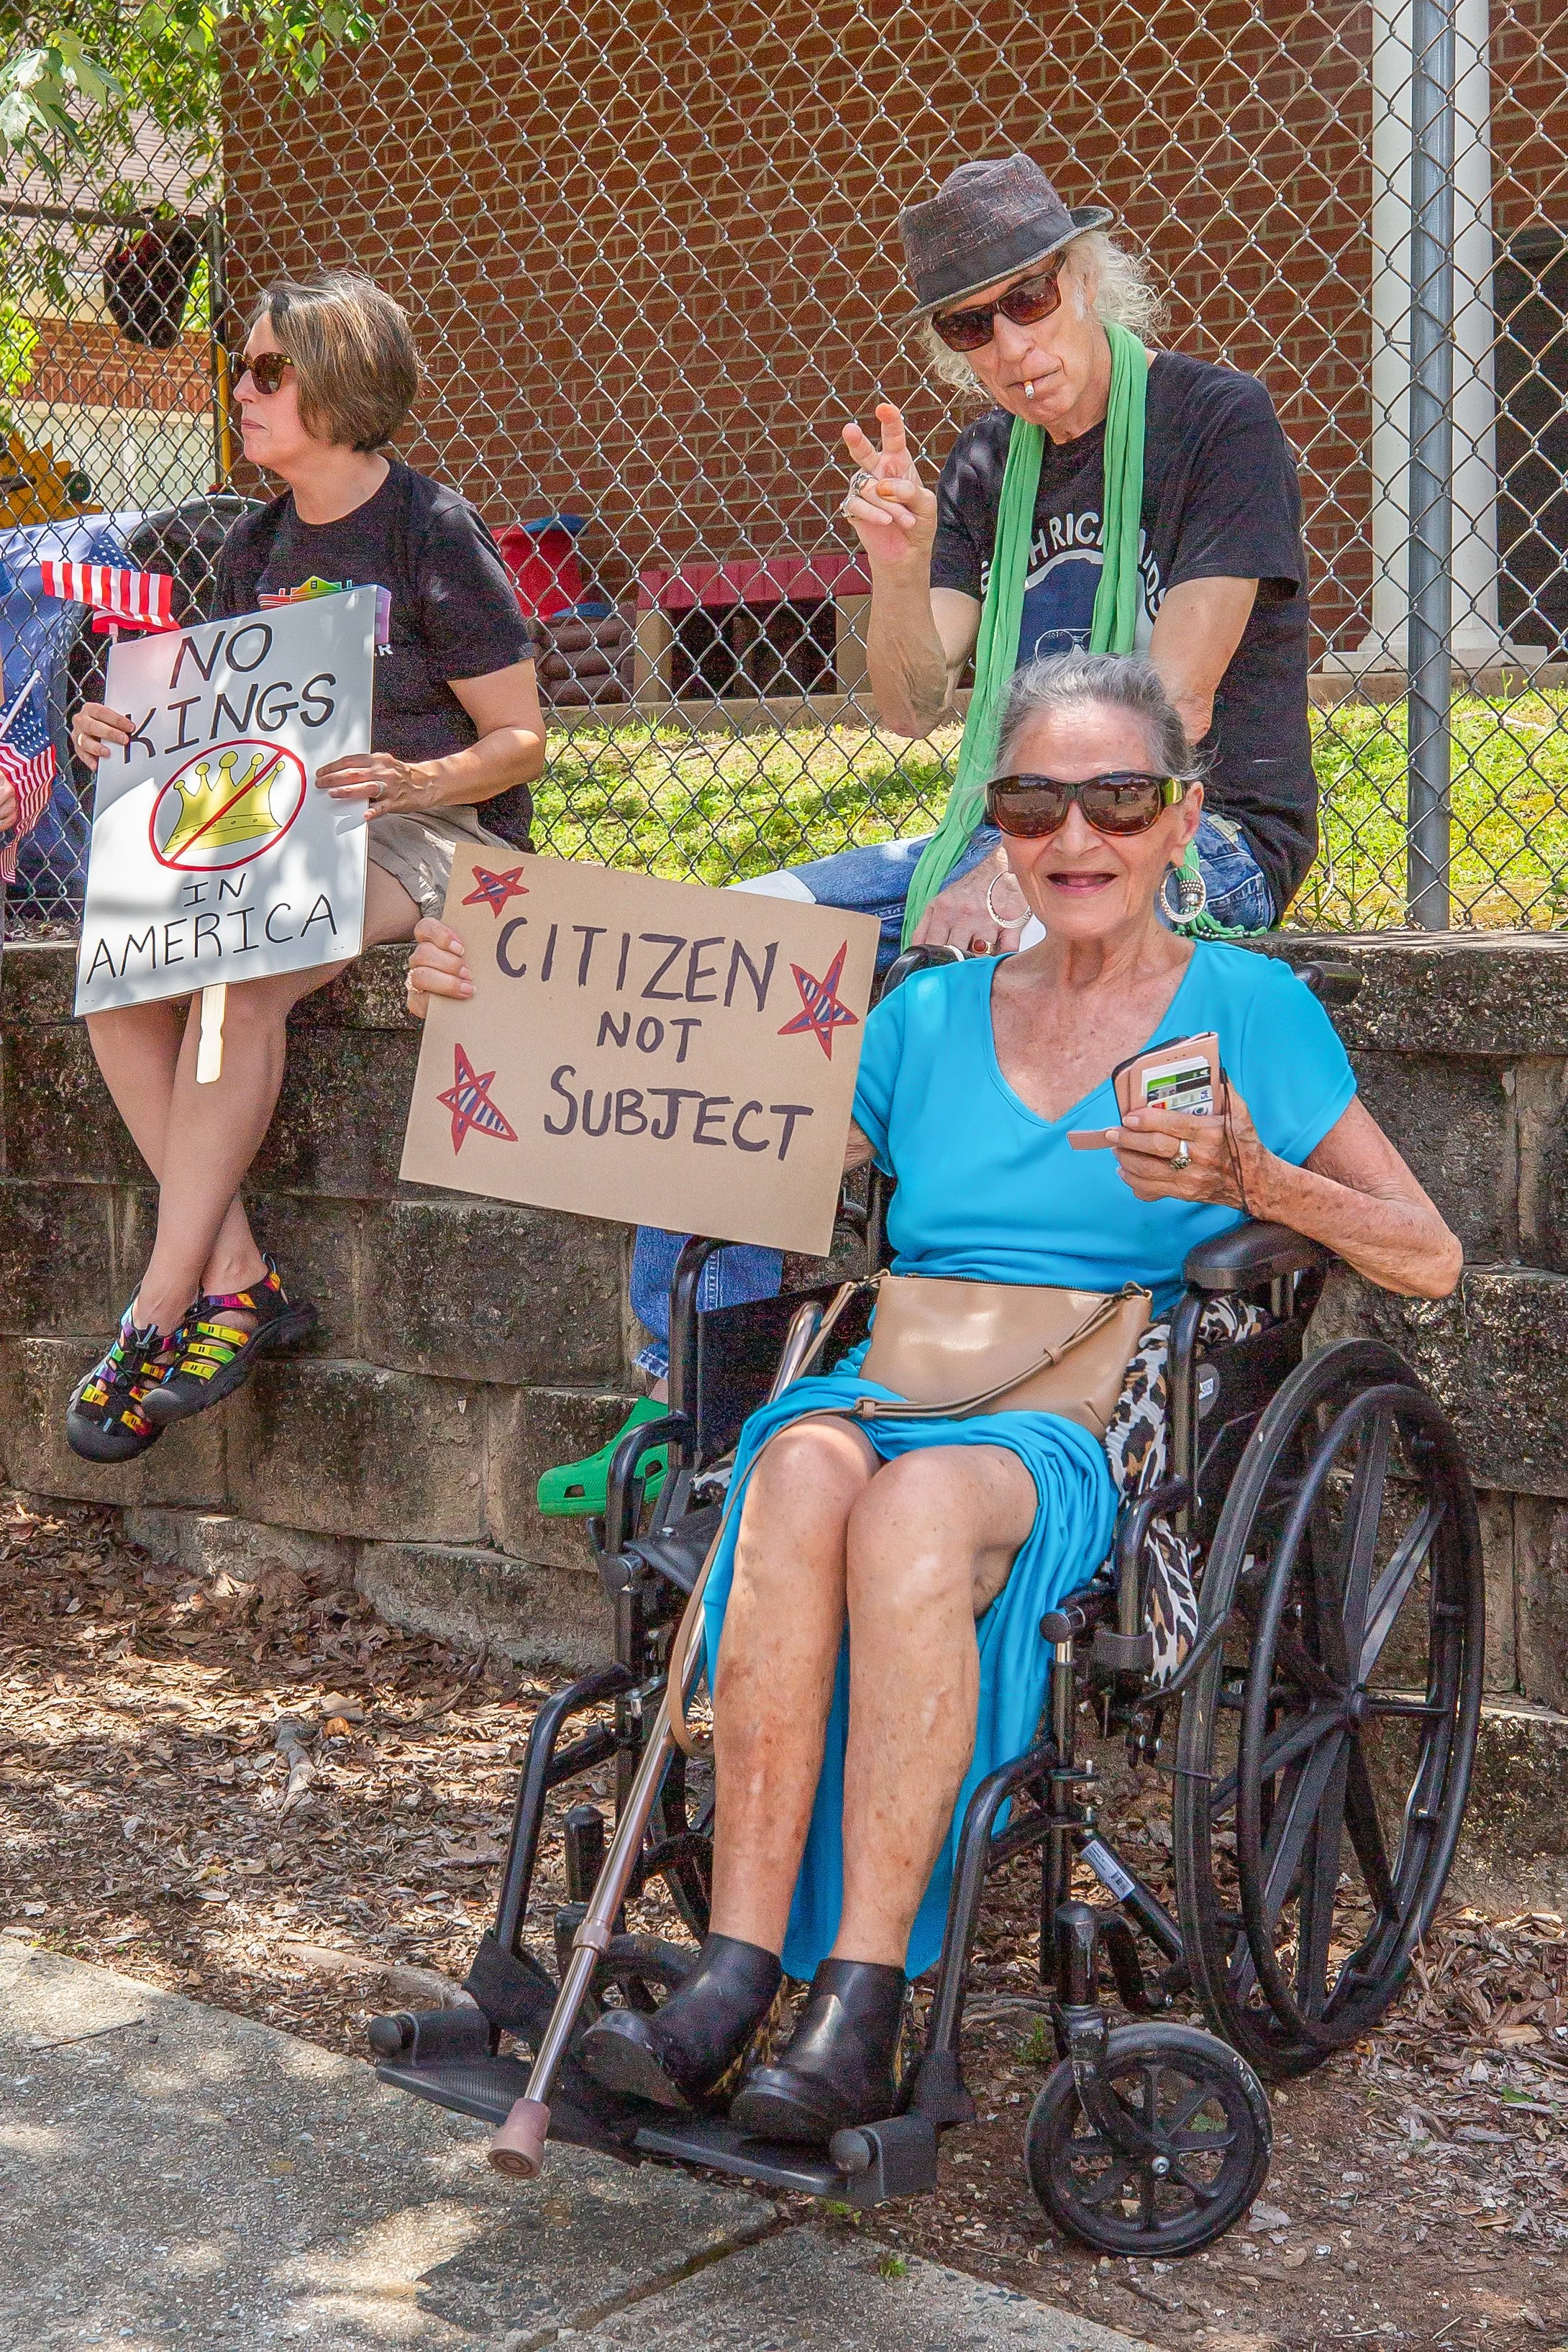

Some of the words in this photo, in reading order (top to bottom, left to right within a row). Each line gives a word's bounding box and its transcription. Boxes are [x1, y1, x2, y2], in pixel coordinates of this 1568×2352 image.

[169, 622, 273, 689] NO
[124, 673, 336, 765] KINGS
[183, 872, 246, 907] IN
[86, 893, 337, 985] AMERICA
[496, 916, 780, 1012] CITIZEN
[596, 1011, 702, 1063] NOT
[544, 1065, 814, 1162] SUBJECT
